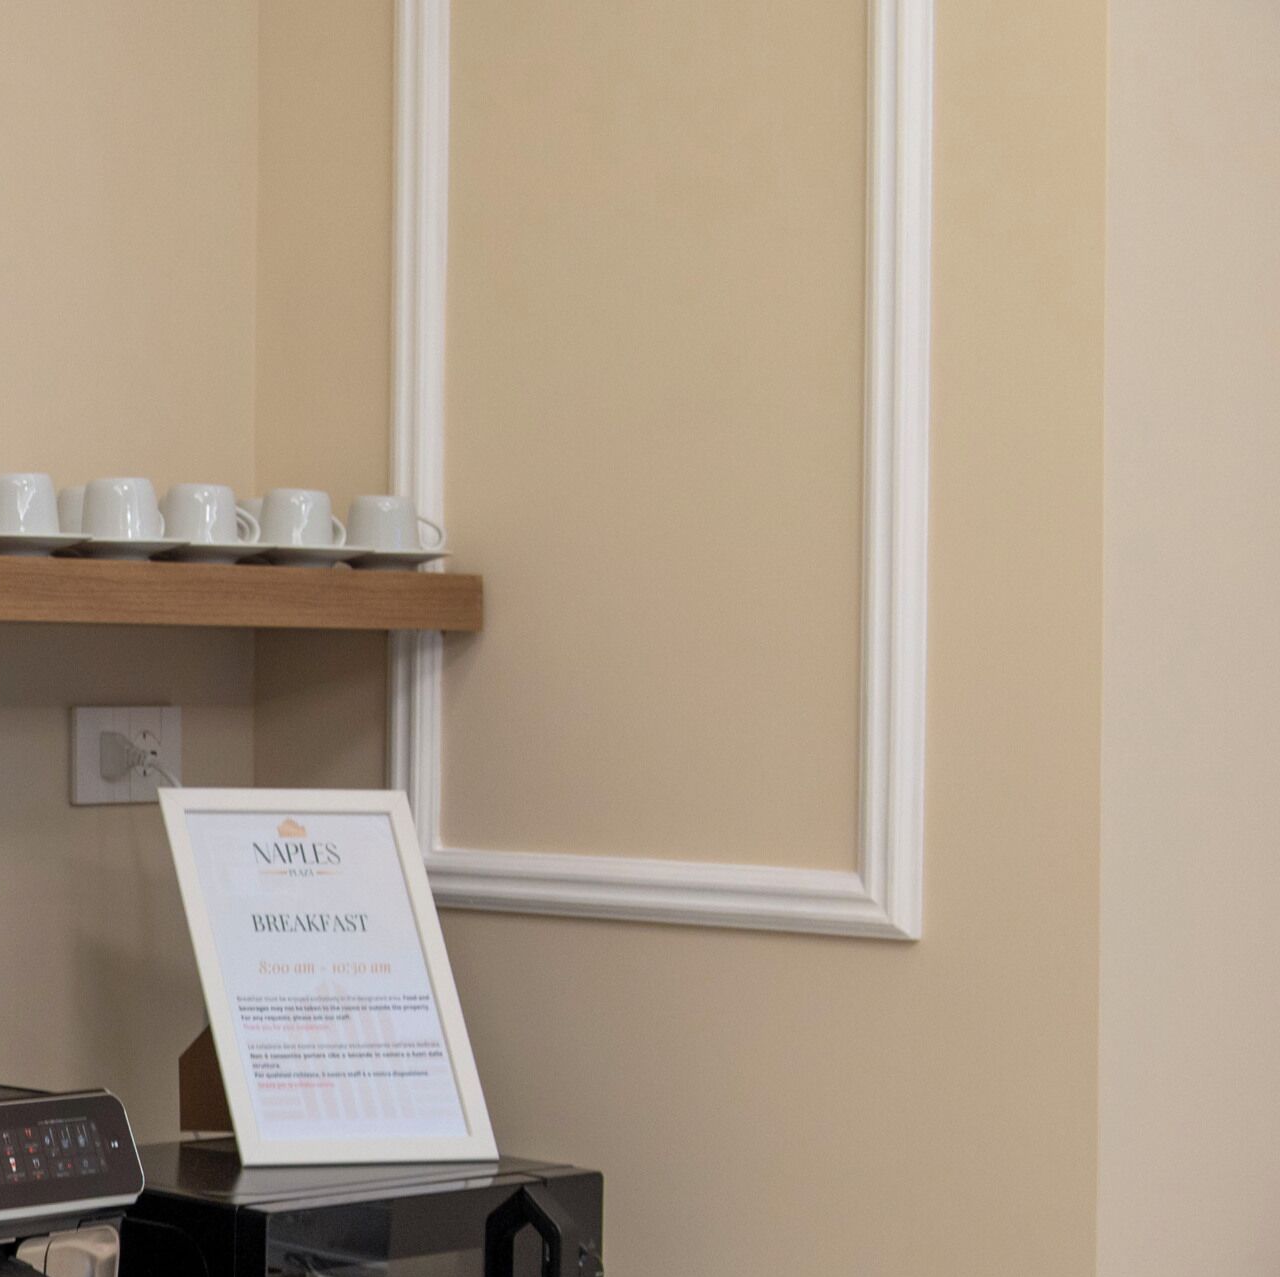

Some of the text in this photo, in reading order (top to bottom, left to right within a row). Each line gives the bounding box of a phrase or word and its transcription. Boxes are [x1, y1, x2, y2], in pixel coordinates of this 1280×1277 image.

[252, 842, 342, 865] NAPLES
[251, 912, 369, 933] BREAKFAST
[258, 961, 290, 975] 8:00
